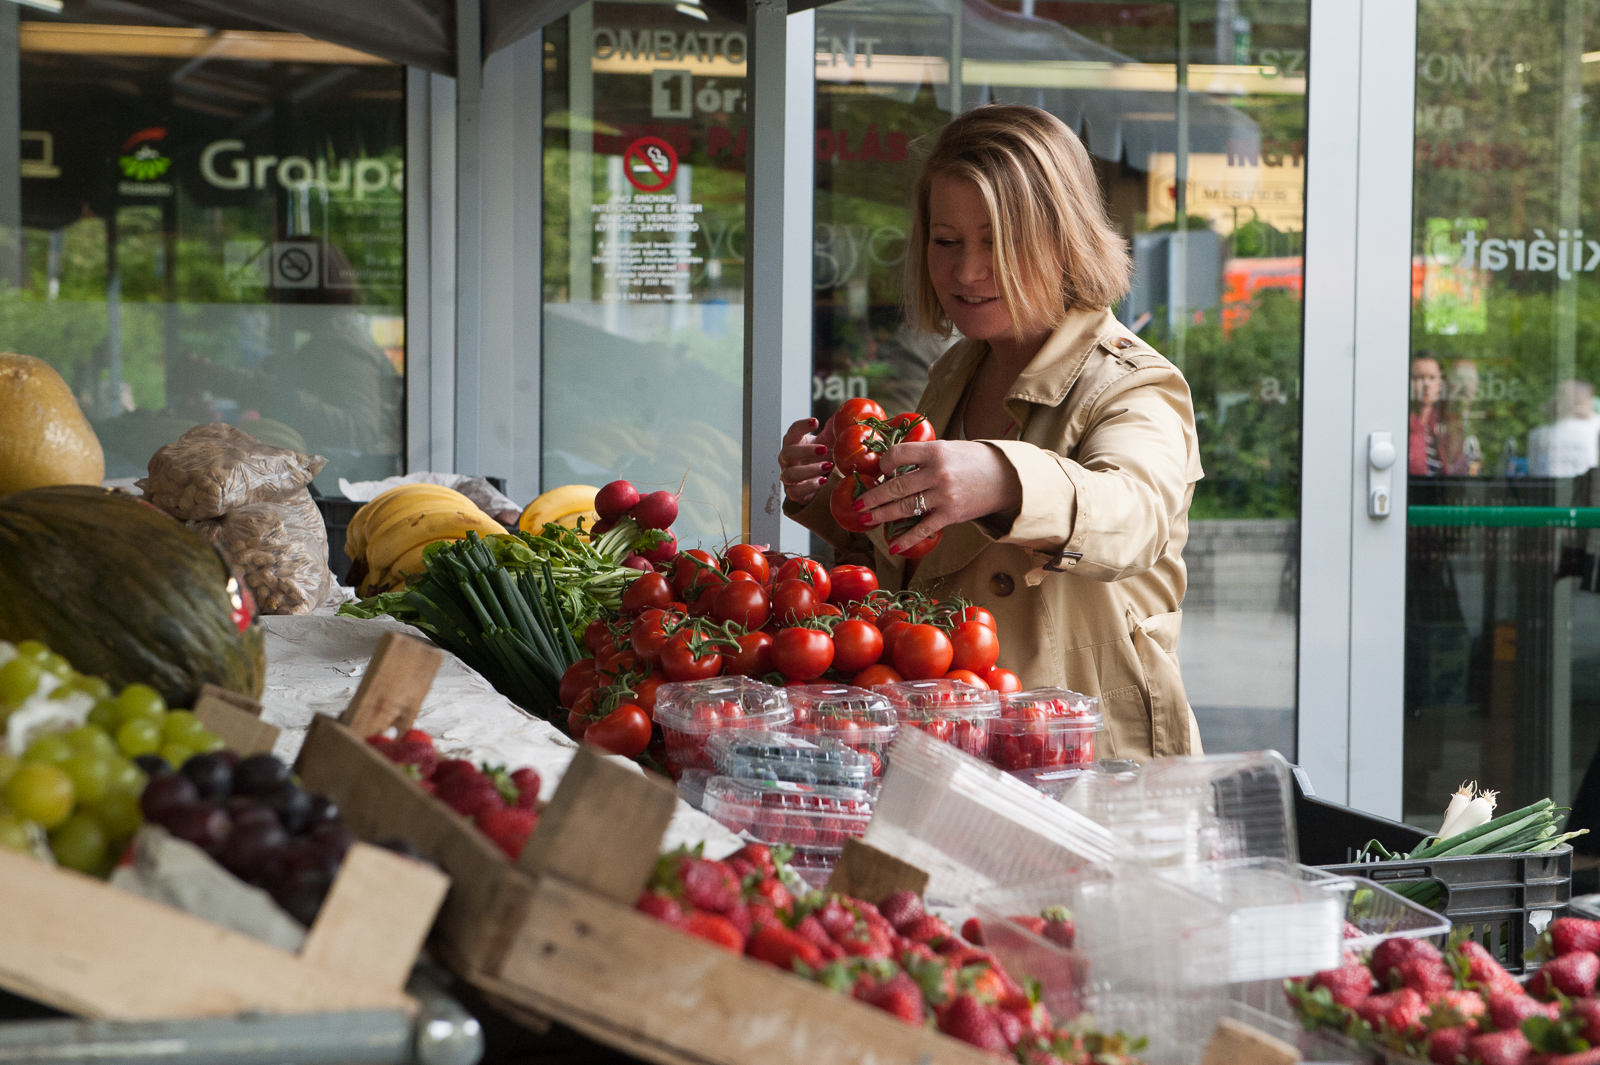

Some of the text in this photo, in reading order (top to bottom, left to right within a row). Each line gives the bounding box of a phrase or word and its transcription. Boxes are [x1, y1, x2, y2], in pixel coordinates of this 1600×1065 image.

[1228, 138, 1304, 167] INGY
[633, 194, 677, 203] SMOKING
[655, 203, 668, 213] DE
[670, 204, 703, 213] FUMER
[646, 213, 695, 223] VERBOTEN
